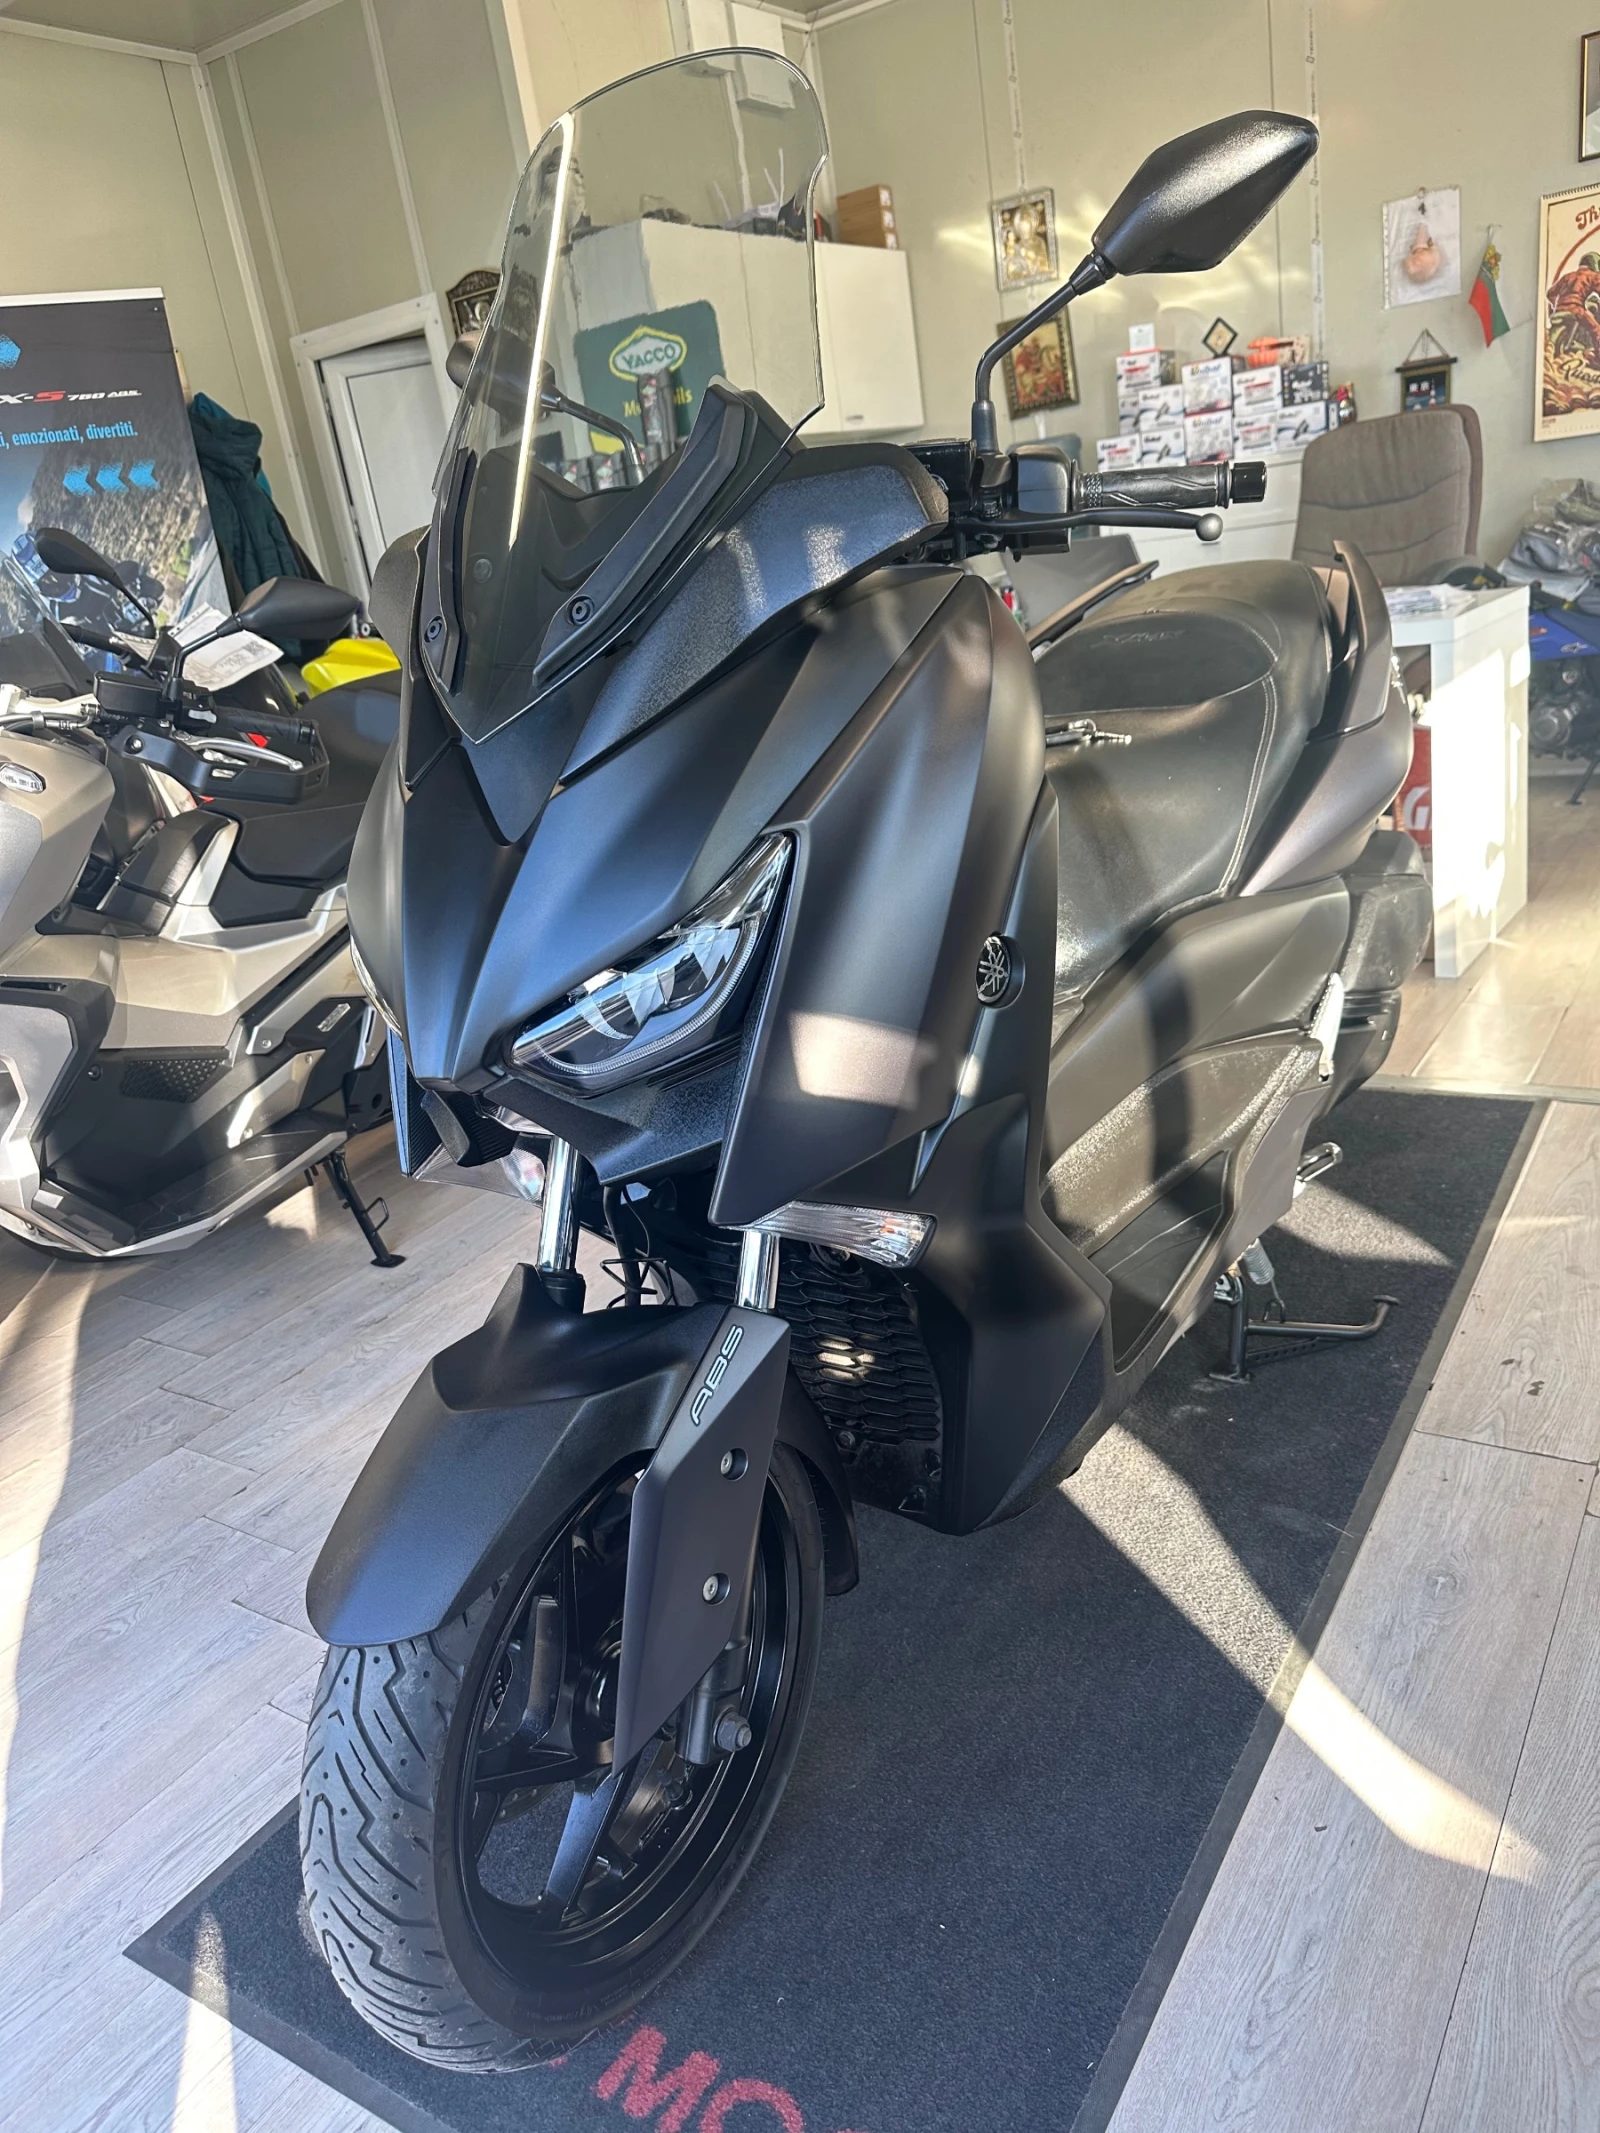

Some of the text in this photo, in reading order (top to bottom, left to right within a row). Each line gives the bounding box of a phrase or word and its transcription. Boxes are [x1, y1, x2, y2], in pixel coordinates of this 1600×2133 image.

[1575, 204, 1600, 230] Th
[67, 392, 105, 401] 750
[12, 425, 84, 446] emozionati,
[86, 421, 139, 440] divertiti.
[689, 1324, 744, 1426] ABS
